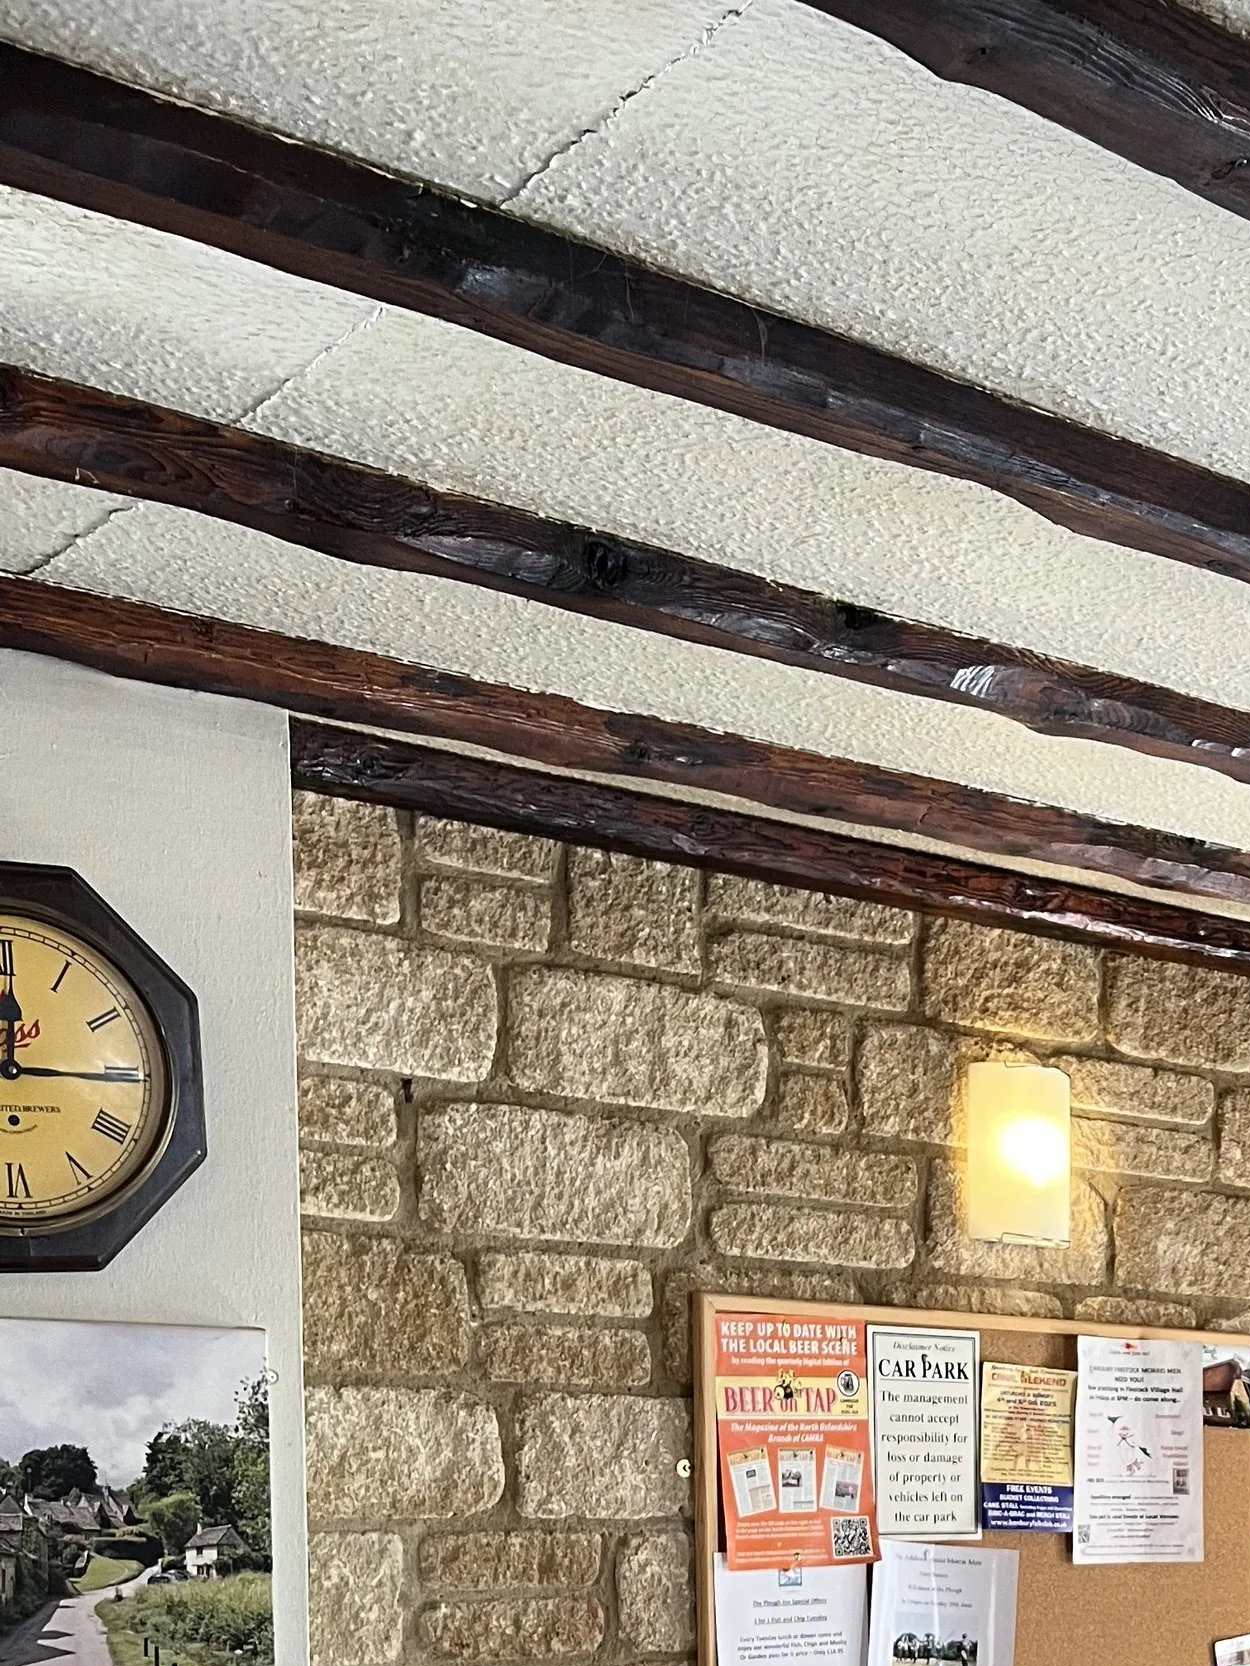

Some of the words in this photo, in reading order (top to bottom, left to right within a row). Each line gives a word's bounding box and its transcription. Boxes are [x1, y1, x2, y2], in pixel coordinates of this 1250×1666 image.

[22, 1105, 61, 1113] BREWERS
[721, 1321, 754, 1336] KEEP
[757, 1322, 774, 1337] UP
[776, 1323, 791, 1337] TO
[794, 1324, 823, 1338] DATE
[826, 1325, 857, 1339] WITH
[721, 1338, 746, 1353] THE
[749, 1339, 787, 1354] LOCAL
[789, 1341, 819, 1354] BEER
[822, 1341, 858, 1356] SCENE
[893, 1341, 932, 1351] Disclaimer
[934, 1343, 956, 1352] Notice
[731, 1356, 739, 1365] by
[741, 1357, 765, 1366] reading
[765, 1357, 775, 1365] the
[878, 1358, 916, 1378] CAR
[921, 1360, 969, 1380] PARK
[724, 1386, 774, 1413] BEER
[780, 1398, 798, 1413] on
[802, 1387, 837, 1413] TAP
[880, 1390, 900, 1402] The
[903, 1394, 968, 1405] management
[889, 1413, 924, 1423] cannot
[927, 1414, 959, 1426] accept
[731, 1423, 743, 1432] The
[745, 1423, 778, 1433] Magazine
[779, 1423, 786, 1432] of
[787, 1423, 798, 1432] the
[800, 1423, 819, 1432] North
[820, 1423, 857, 1432] Oxfordshire
[768, 1434, 793, 1443] Branch
[793, 1434, 800, 1443] of
[801, 1434, 824, 1443] CAMRA
[881, 1431, 949, 1446] responsibility
[953, 1432, 968, 1443] for
[887, 1451, 906, 1462] loss
[909, 1454, 920, 1462] or
[924, 1452, 963, 1465] damage
[889, 1471, 900, 1482] of
[903, 1473, 947, 1485] property
[950, 1474, 961, 1482] or
[1006, 1484, 1025, 1493] FREE
[1025, 1486, 1052, 1494] EVENTS
[889, 1491, 928, 1502] vehicles
[932, 1491, 947, 1502] left
[950, 1494, 963, 1502] on
[895, 1511, 911, 1522] the
[914, 1514, 930, 1522] car
[933, 1511, 957, 1524] park
[794, 1615, 805, 1623] Chip
